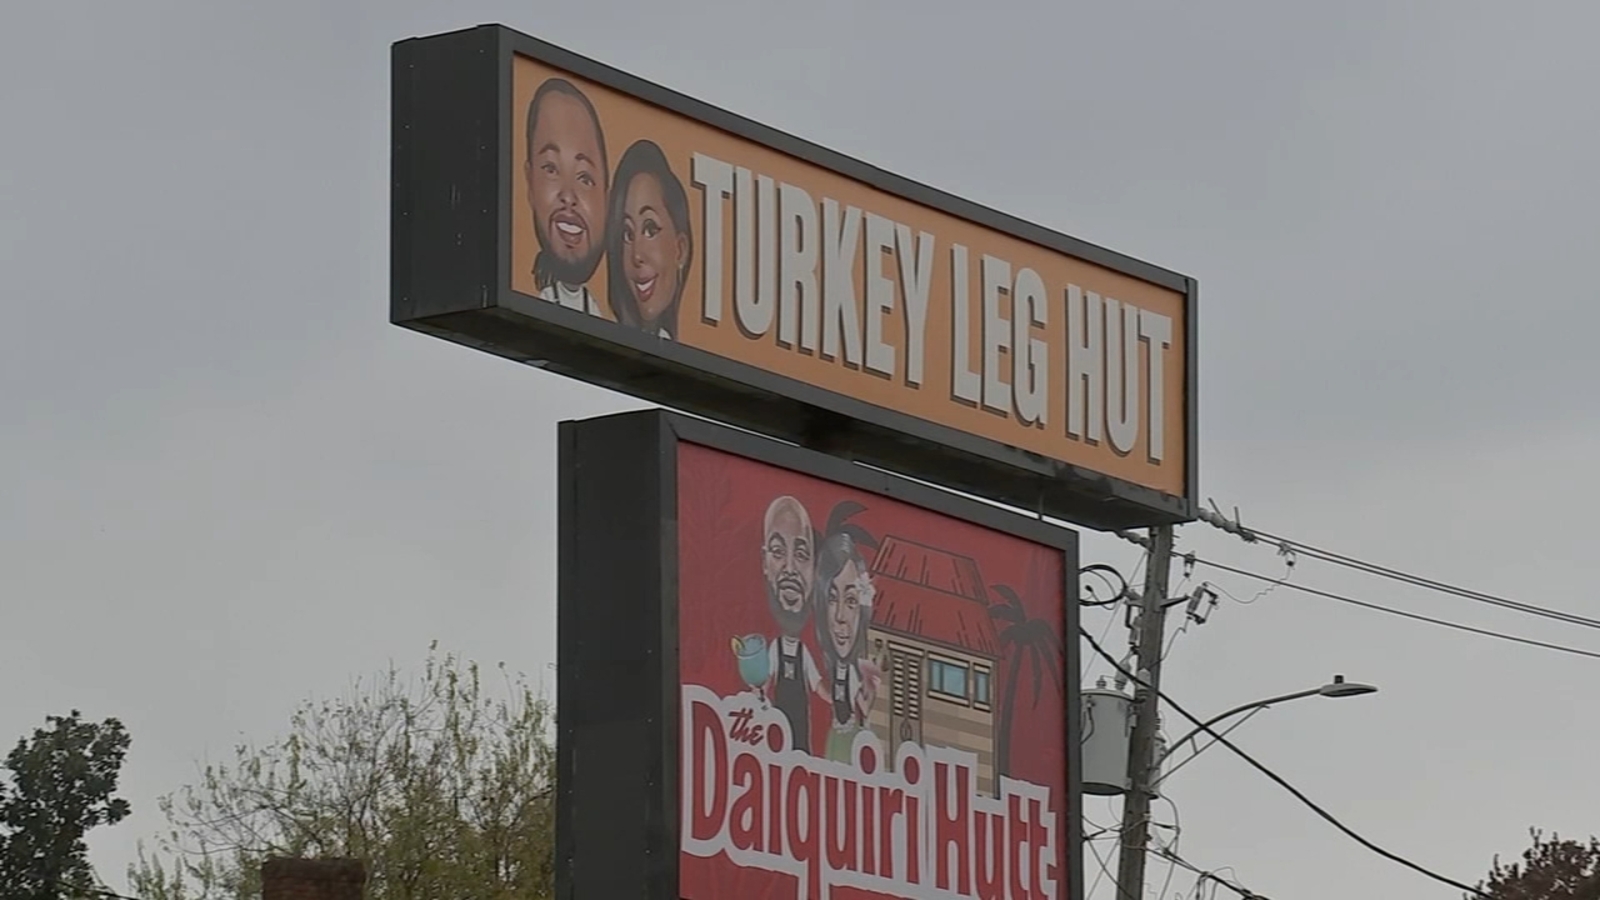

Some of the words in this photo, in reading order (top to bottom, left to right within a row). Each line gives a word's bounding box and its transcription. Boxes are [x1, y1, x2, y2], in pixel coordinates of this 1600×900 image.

[690, 151, 935, 389] TURKEY
[950, 243, 1048, 431] LEG
[1064, 283, 1172, 466] HUT
[691, 700, 921, 900] Daiquiri
[934, 761, 1048, 900] Hutt
[728, 708, 765, 746] the
